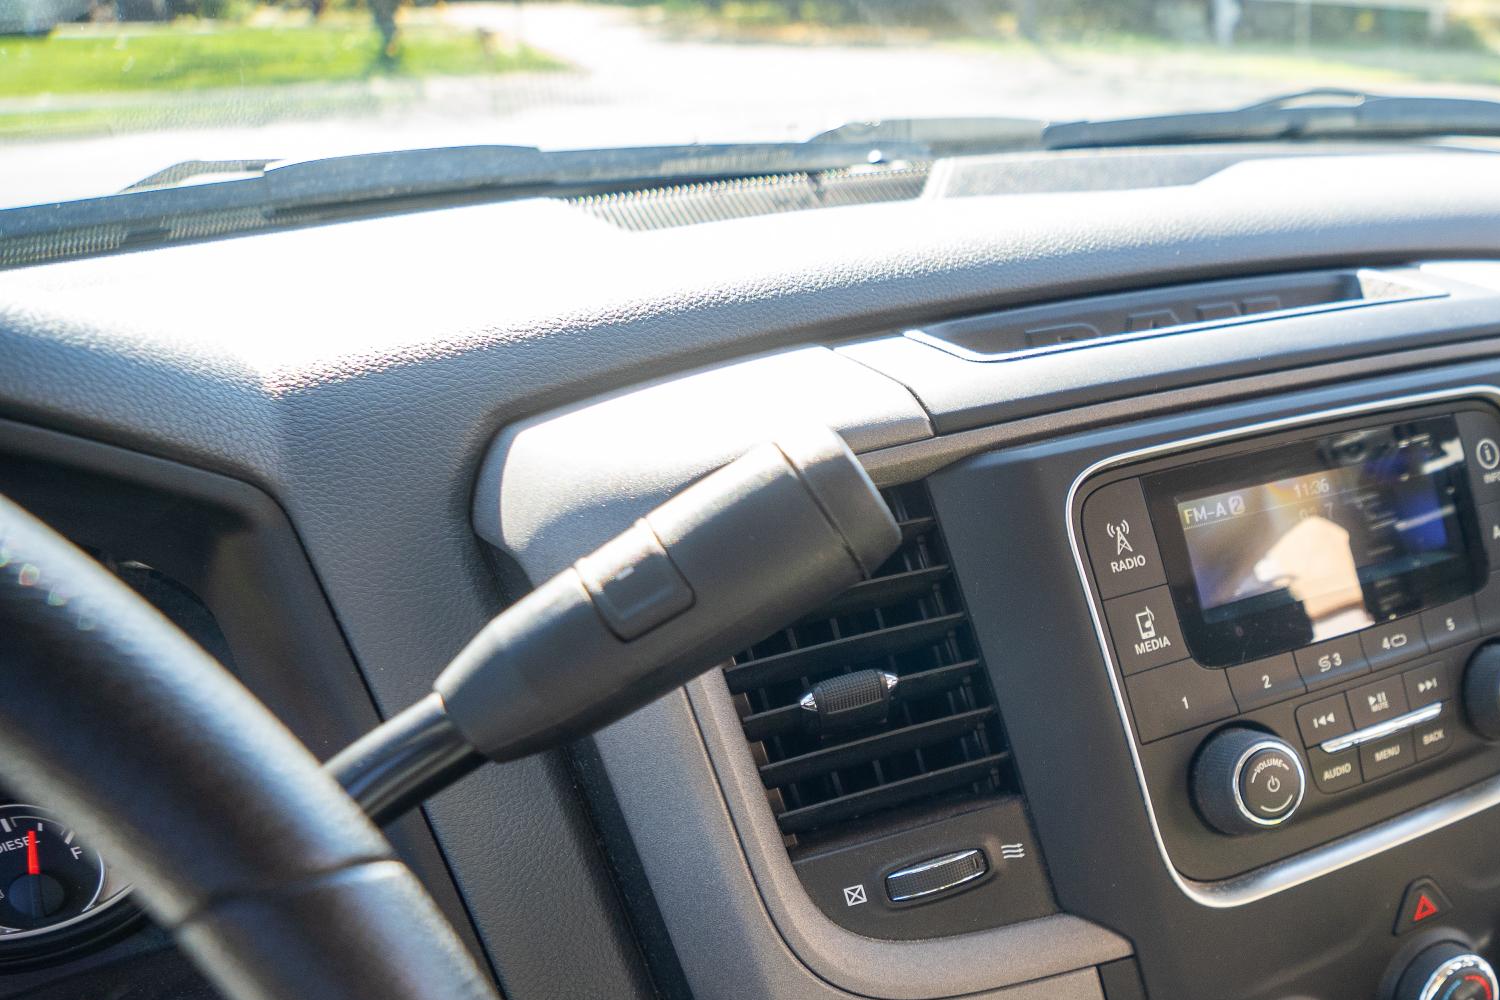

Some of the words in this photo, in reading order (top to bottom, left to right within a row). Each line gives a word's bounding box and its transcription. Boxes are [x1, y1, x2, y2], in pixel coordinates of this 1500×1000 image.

[1184, 505, 1227, 524] FM-A
[1111, 555, 1146, 573] RADIO
[1446, 618, 1455, 631] 5
[1134, 636, 1171, 655] MEDIA
[1381, 637, 1391, 650] 4
[1333, 653, 1342, 667] 3
[1262, 675, 1272, 689] 2
[1182, 696, 1189, 709] 1
[1375, 745, 1400, 762] MENU
[1254, 758, 1283, 773] VOLUME
[1323, 762, 1351, 781] AUDIO
[70, 846, 82, 860] F
